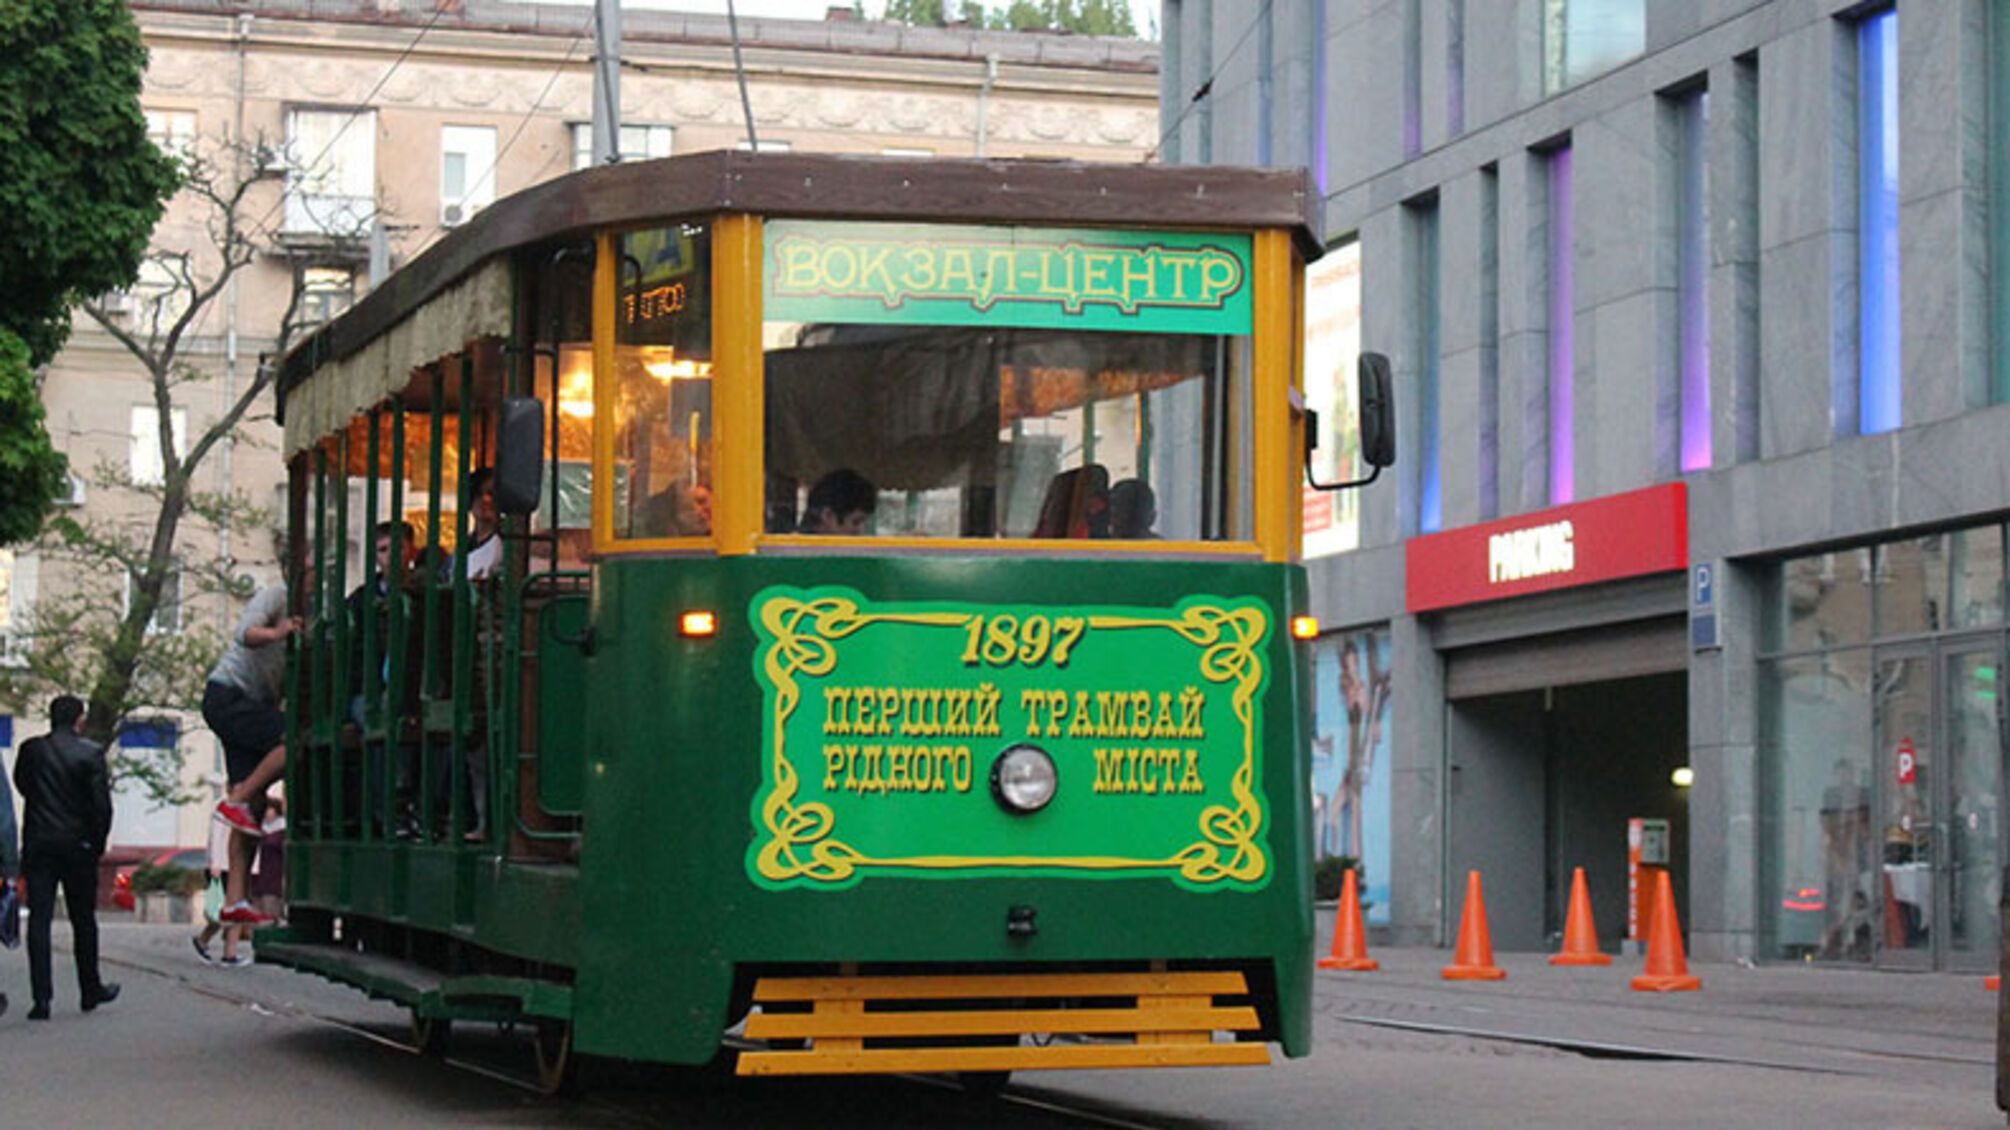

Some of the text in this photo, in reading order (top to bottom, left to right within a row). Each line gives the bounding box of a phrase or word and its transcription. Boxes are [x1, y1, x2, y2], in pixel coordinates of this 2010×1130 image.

[783, 242, 1237, 304] ВОКЗАЛ-ЦЕНТР
[961, 614, 1086, 665] 1897
[823, 682, 1205, 739] ПЕРШИЙ ТРАМВАЙ
[823, 744, 1205, 796] РІДНОГО МІСТА
